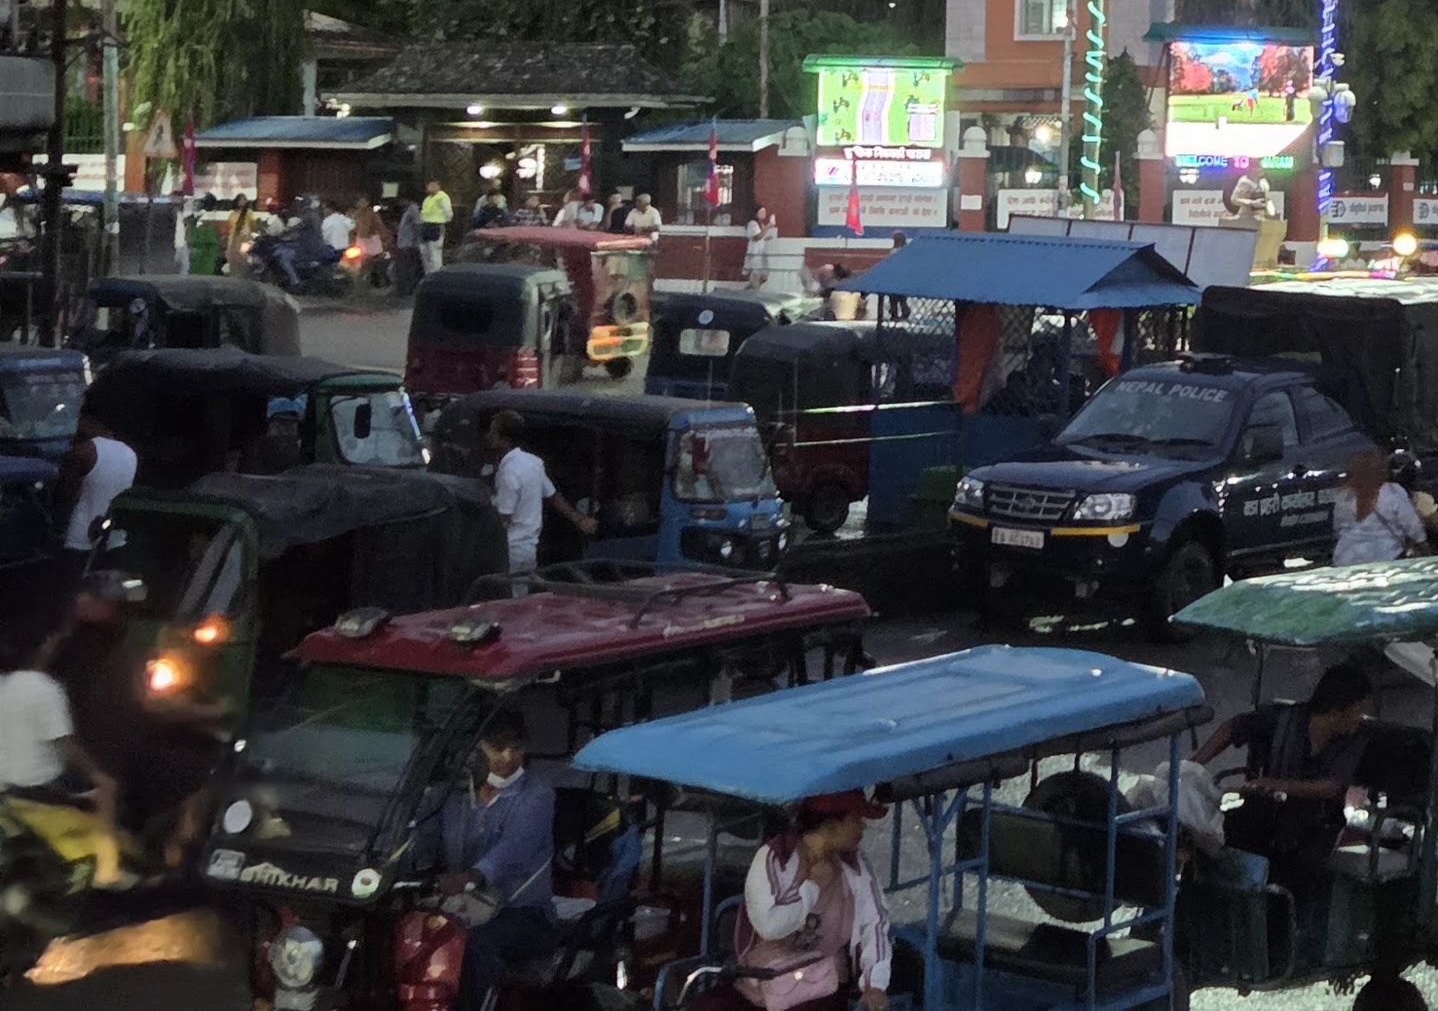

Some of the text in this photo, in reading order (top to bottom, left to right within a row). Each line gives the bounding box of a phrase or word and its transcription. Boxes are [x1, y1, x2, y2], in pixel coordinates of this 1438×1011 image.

[1233, 156, 1250, 168] TO
[1115, 380, 1229, 403] NEPAL POLICE
